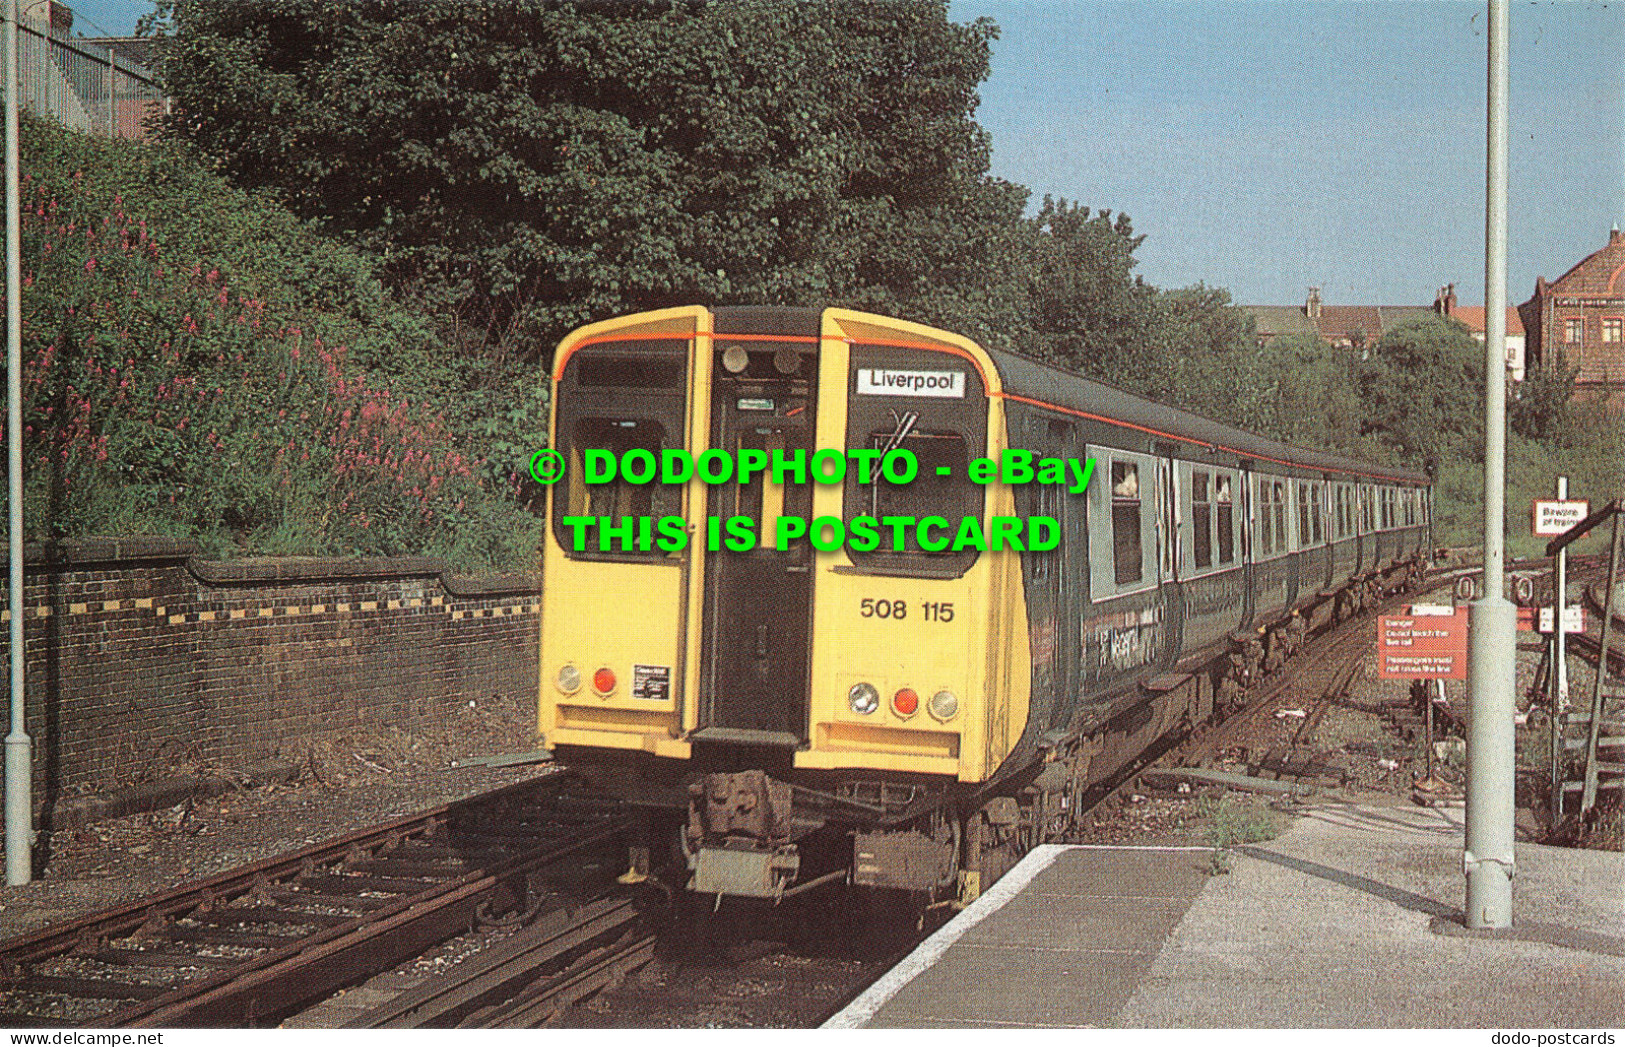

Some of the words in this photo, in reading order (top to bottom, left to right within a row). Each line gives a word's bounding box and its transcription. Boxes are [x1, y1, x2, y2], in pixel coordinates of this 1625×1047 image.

[870, 370, 955, 391] Liverpool
[861, 599, 907, 620] 508
[922, 602, 954, 623] 115
